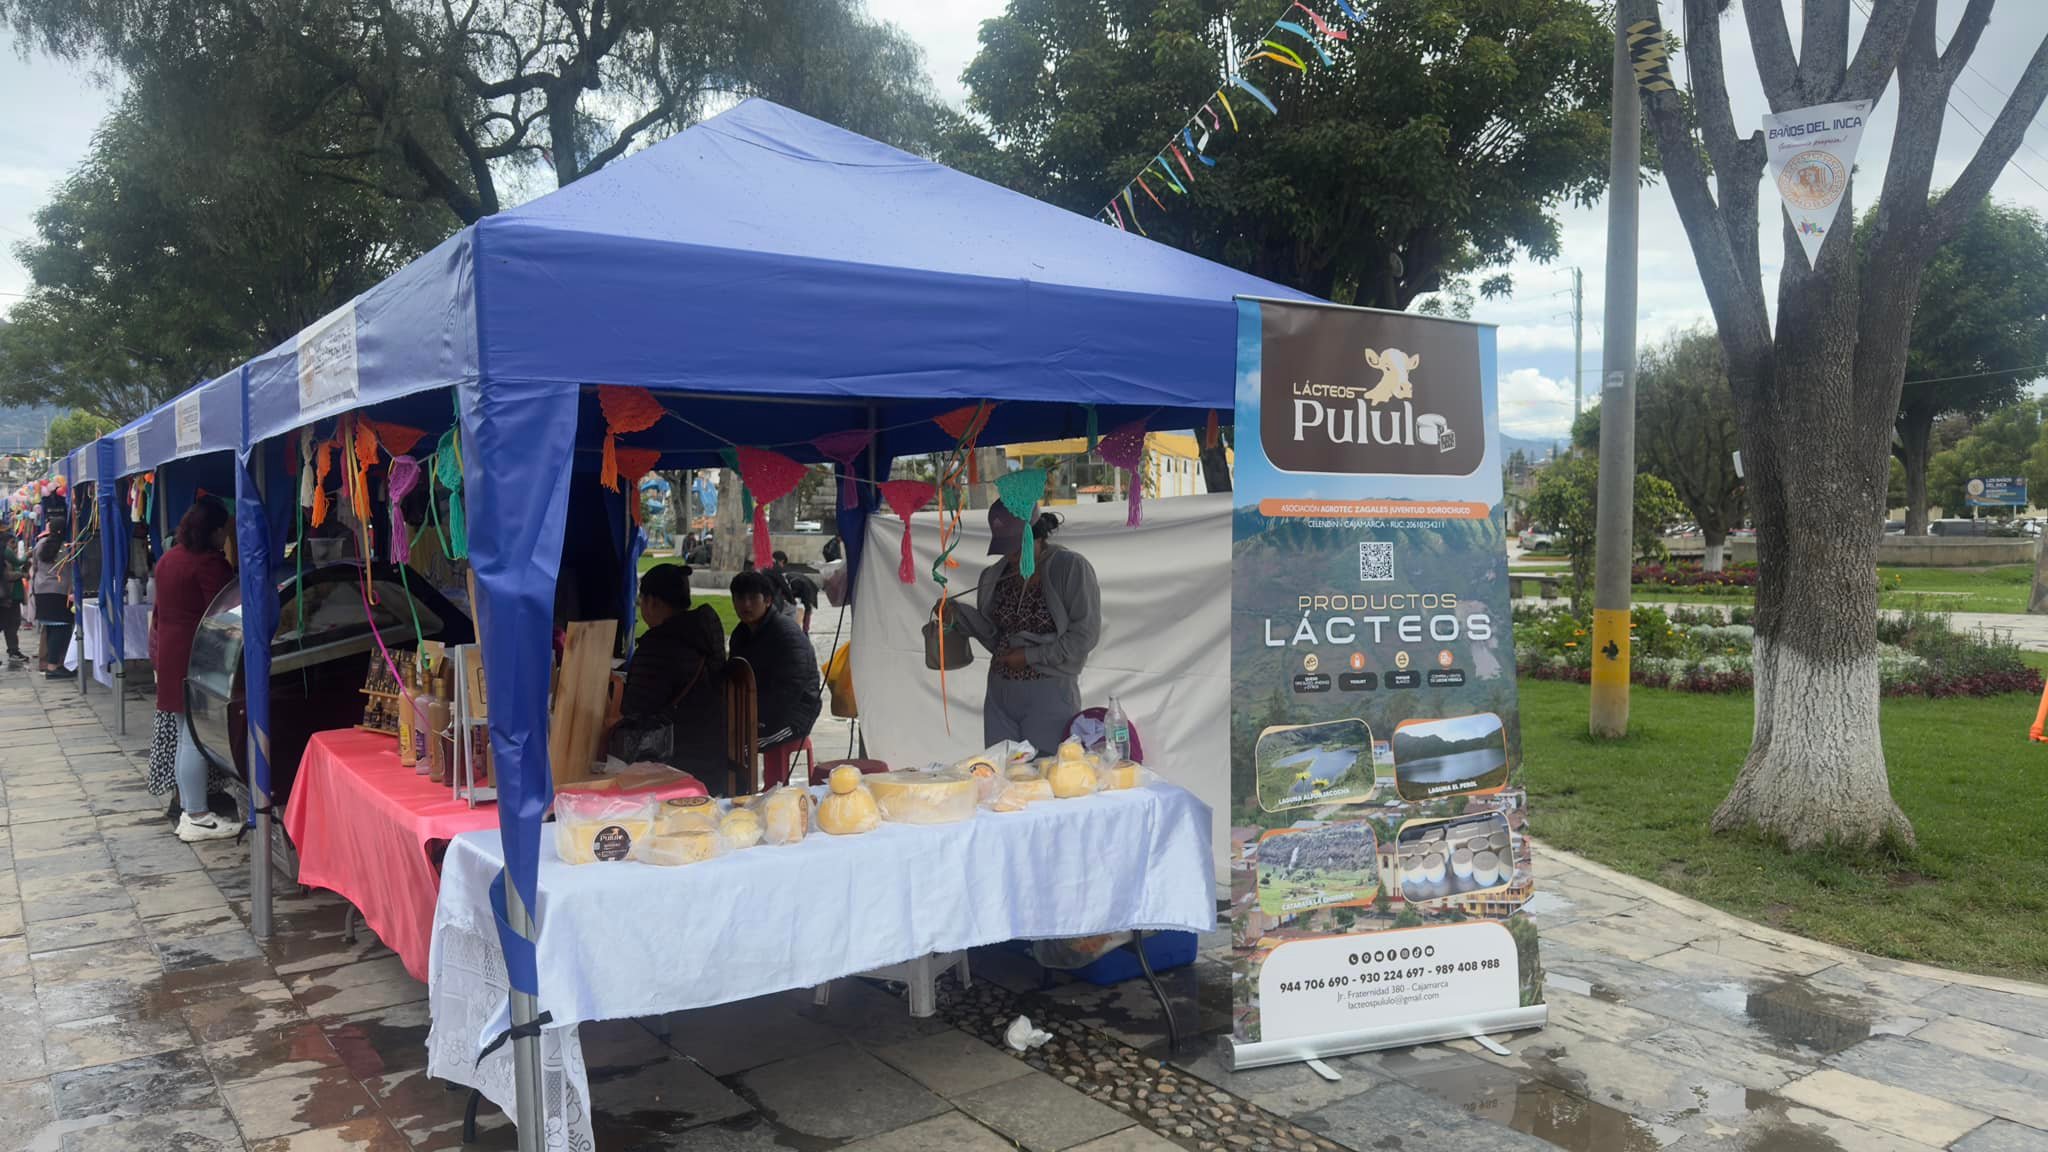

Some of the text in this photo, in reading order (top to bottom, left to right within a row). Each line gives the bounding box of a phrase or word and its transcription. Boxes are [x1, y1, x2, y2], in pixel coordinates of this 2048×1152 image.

[1769, 117, 1862, 139] BAÑOS DEL INCA
[1294, 380, 1356, 399] LÁCTEOS
[1321, 505, 1353, 513] AGROTEC
[1355, 505, 1388, 513] ZAGALES
[1390, 505, 1425, 514] JUVENTUD
[1344, 520, 1385, 530] CAJAMARCA
[1299, 593, 1457, 611] PRODUCTOS
[1265, 609, 1492, 647] LÁCTEOS
[1280, 981, 1301, 992] 944
[1304, 979, 1325, 990] 706
[1328, 976, 1349, 987] 690
[1360, 972, 1380, 984] 930
[1383, 969, 1403, 981] 224
[1406, 967, 1425, 978] 697
[1435, 964, 1455, 975] 989
[1458, 961, 1478, 972] 408
[1481, 959, 1500, 970] 988
[1337, 991, 1346, 1003] Jr.
[1347, 987, 1390, 999] Fraternidad
[1392, 985, 1405, 994] 380
[1411, 981, 1449, 992] Cajamarca
[1348, 992, 1440, 1010] lacteospululo@gmail.com
